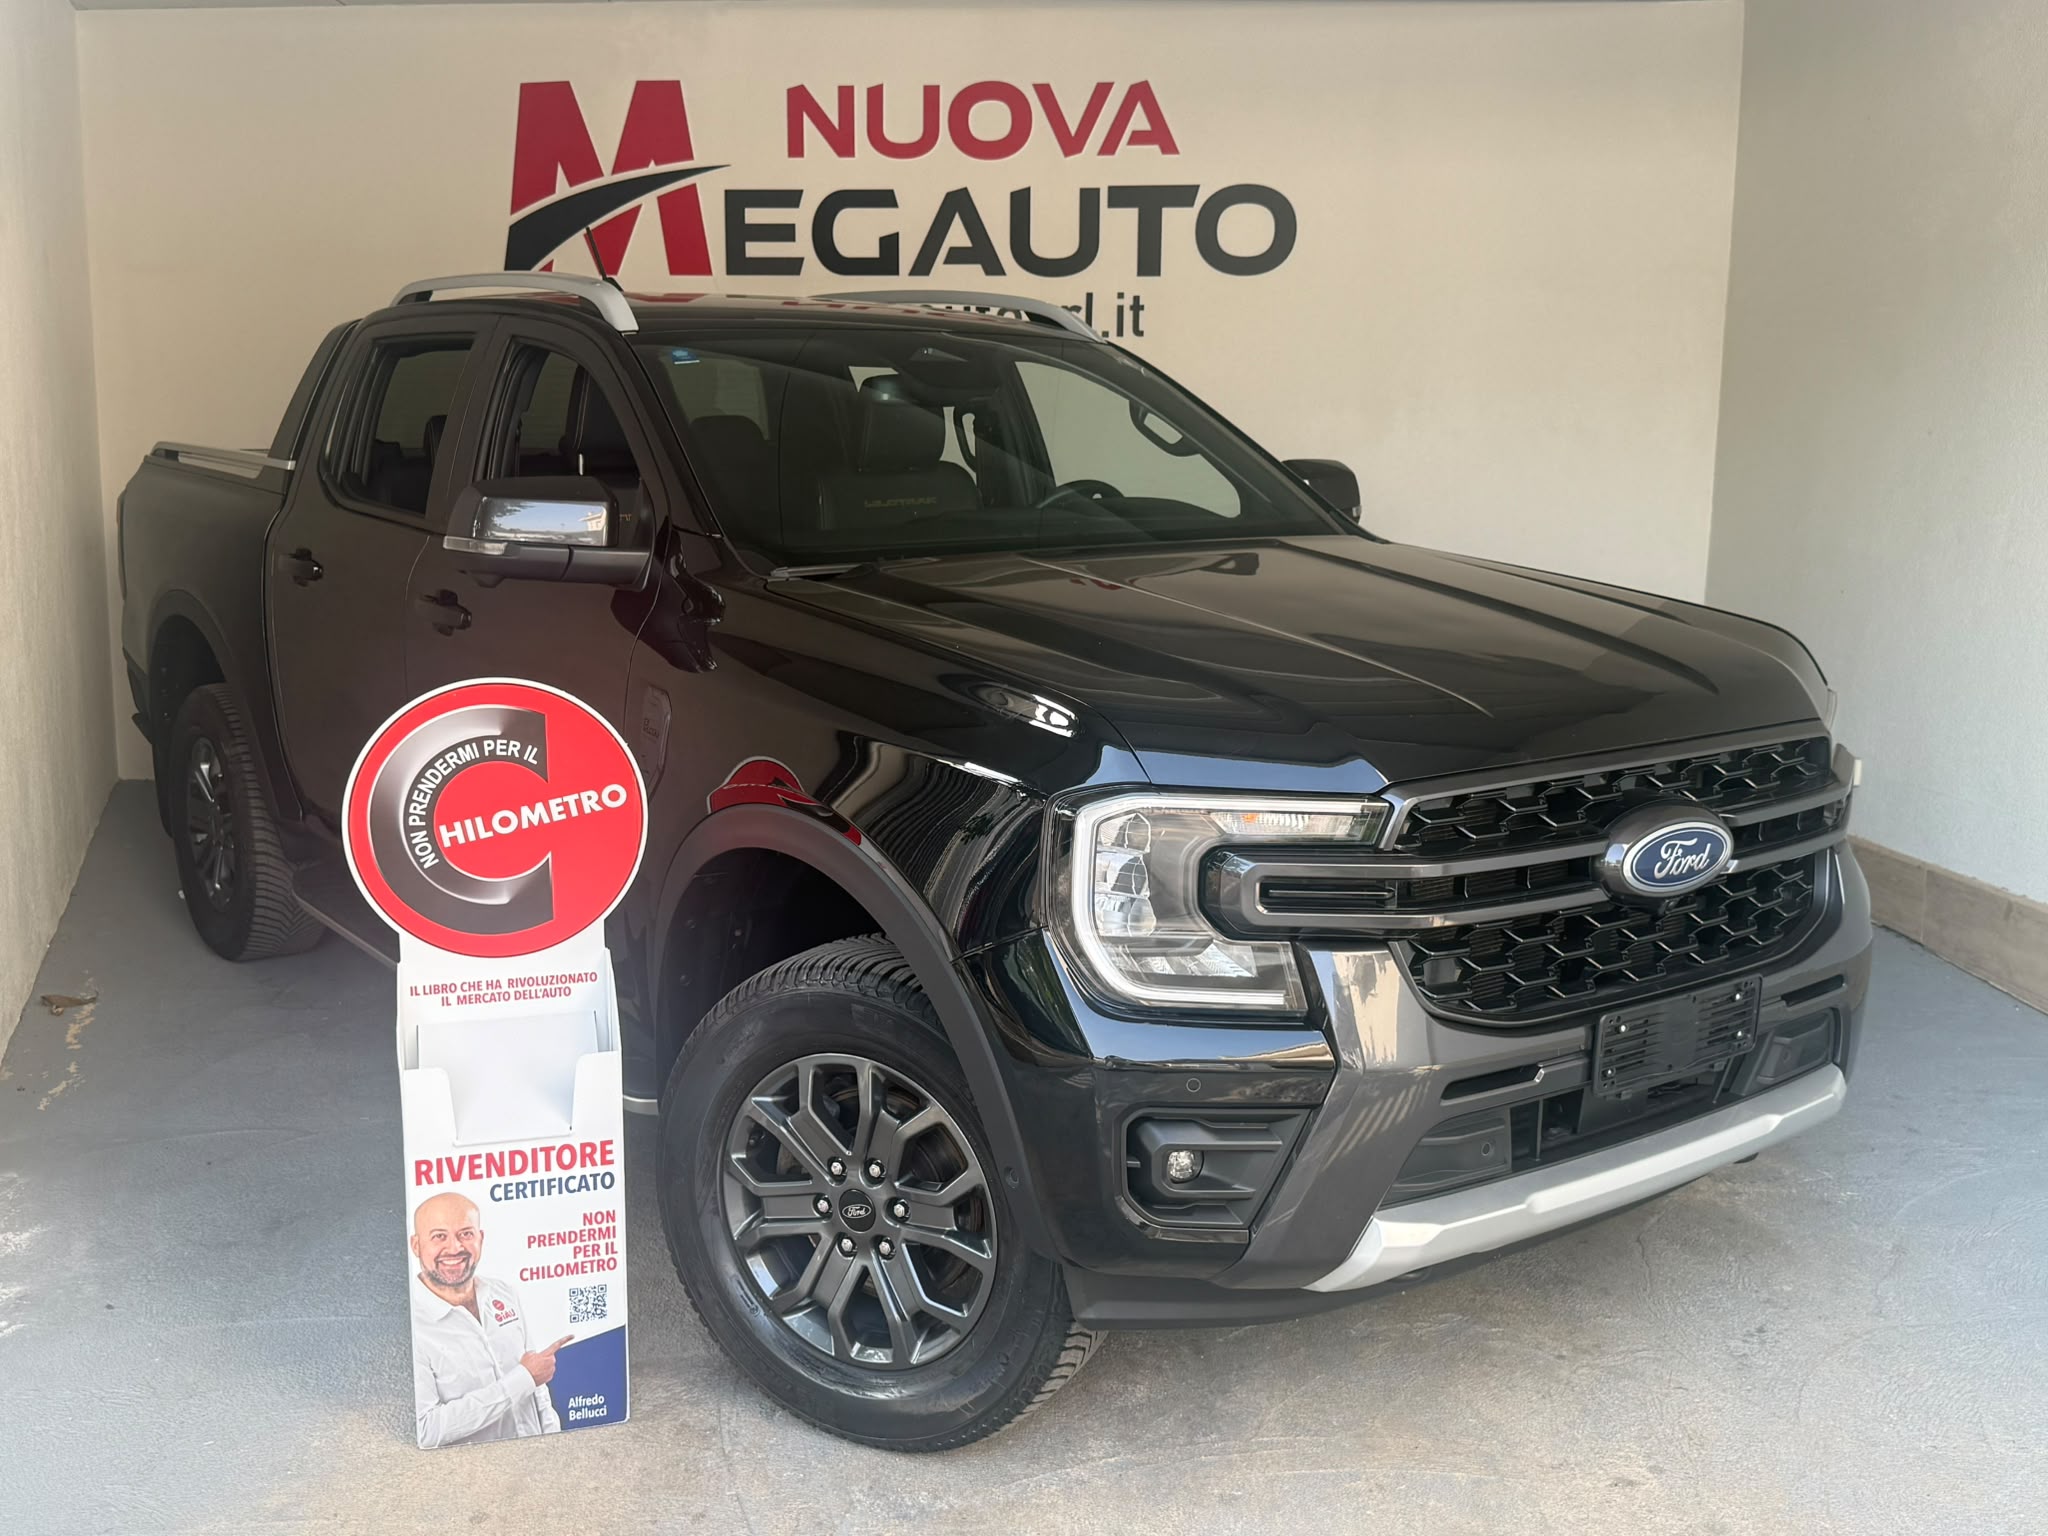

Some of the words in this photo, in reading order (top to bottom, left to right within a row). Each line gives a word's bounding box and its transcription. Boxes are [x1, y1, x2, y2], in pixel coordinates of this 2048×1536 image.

[786, 79, 1180, 159] NUOVA
[483, 739, 521, 757] PER
[523, 744, 539, 765] IL
[408, 741, 480, 827] PRENDERMI
[409, 829, 440, 869] NON
[1653, 837, 1712, 880] Ford
[409, 985, 421, 997] IL
[422, 982, 458, 996] LIBRO
[460, 980, 483, 993] CHE
[486, 979, 503, 991] HA
[507, 971, 598, 989] RIVOLUZIONATO
[441, 996, 452, 1007] IL
[456, 990, 511, 1006] MERCATO
[513, 986, 572, 1001] DELL'AUTO
[414, 1139, 615, 1187] RIVENDITORE
[489, 1171, 616, 1203] CERTIFICATO
[582, 1209, 617, 1227] NON
[847, 1205, 867, 1217] Ford
[526, 1225, 617, 1249] PRENDERMI
[572, 1245, 602, 1260] PER
[605, 1243, 619, 1256] IL
[519, 1256, 618, 1282] CHILOMETRO
[567, 1393, 606, 1409] Alfredo
[568, 1404, 608, 1422] Bellucci
